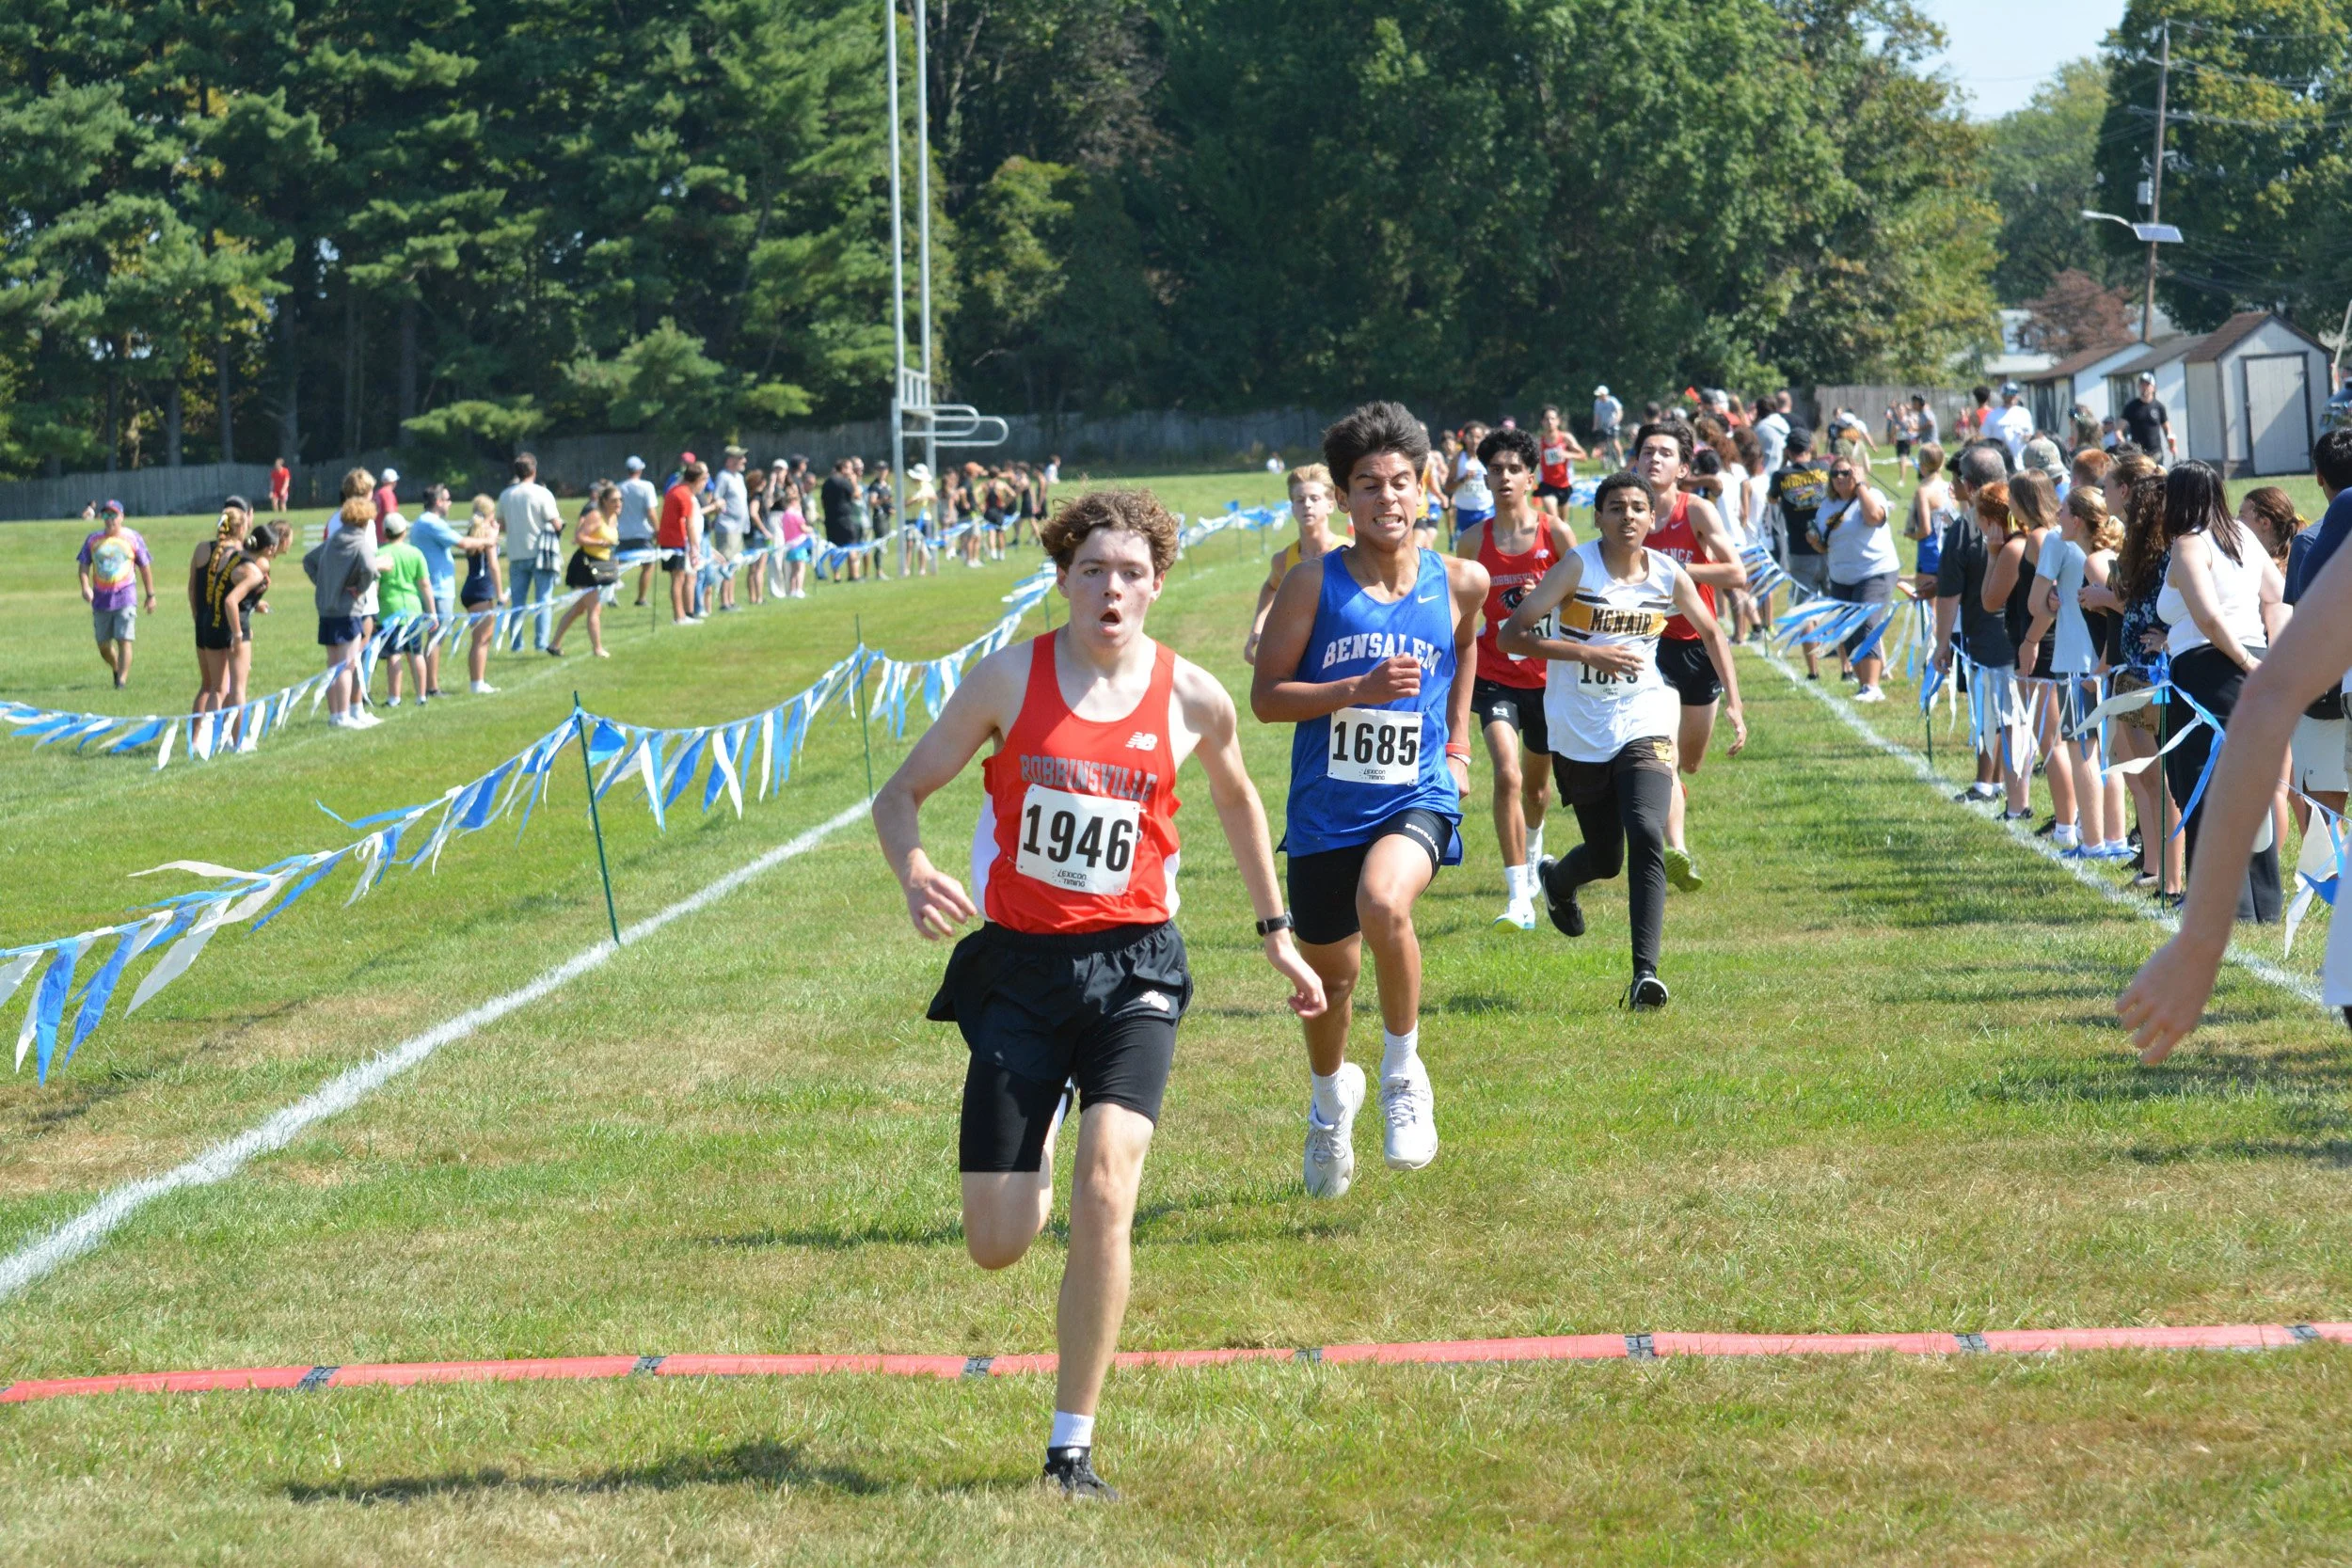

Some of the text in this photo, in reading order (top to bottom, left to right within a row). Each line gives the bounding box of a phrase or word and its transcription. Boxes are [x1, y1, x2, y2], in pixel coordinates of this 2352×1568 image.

[1322, 632, 1442, 677] BENSALEM
[1332, 721, 1419, 766] 1685
[1020, 754, 1158, 800] ROBBINSVILLE
[1023, 804, 1134, 872] 1946
